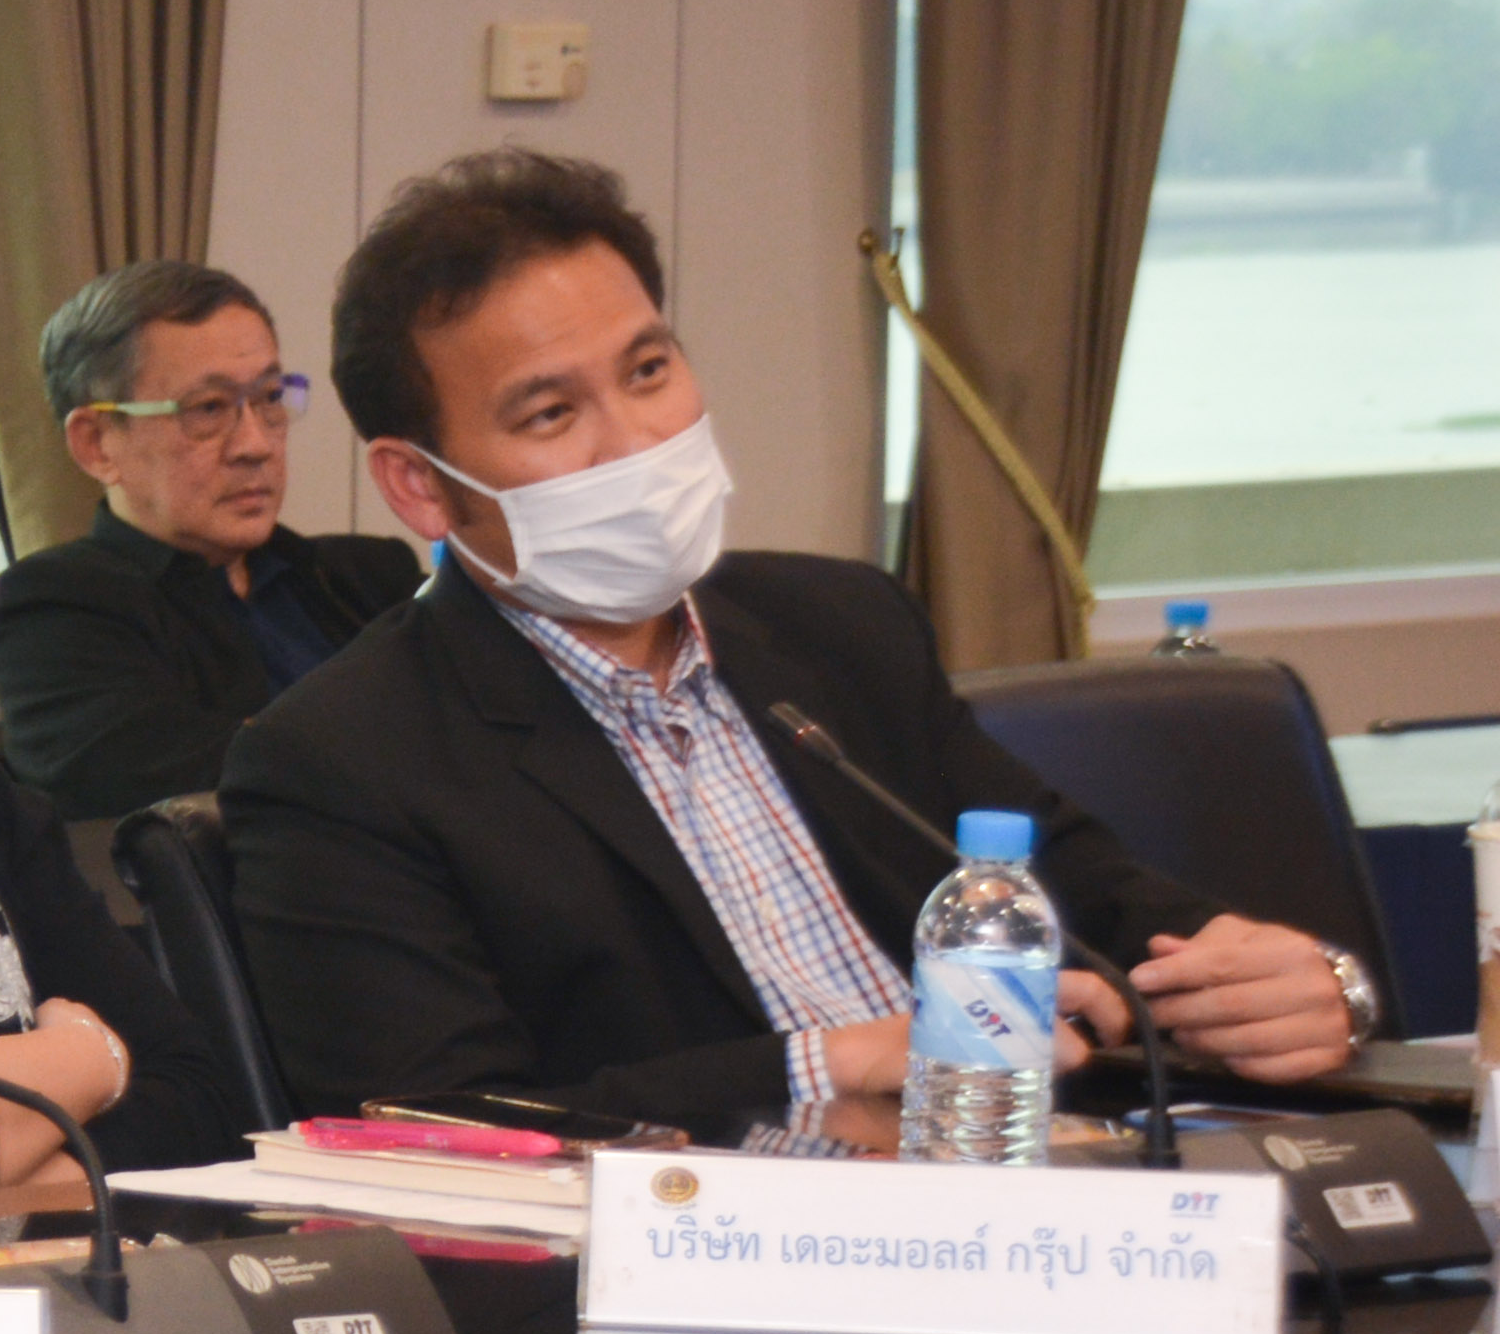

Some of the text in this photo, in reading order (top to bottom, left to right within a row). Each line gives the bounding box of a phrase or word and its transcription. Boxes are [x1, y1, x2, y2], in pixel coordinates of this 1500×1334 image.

[646, 1214, 1217, 1291] บริษัท เดอะมอลล์ กรุ๊ป จำกัด
